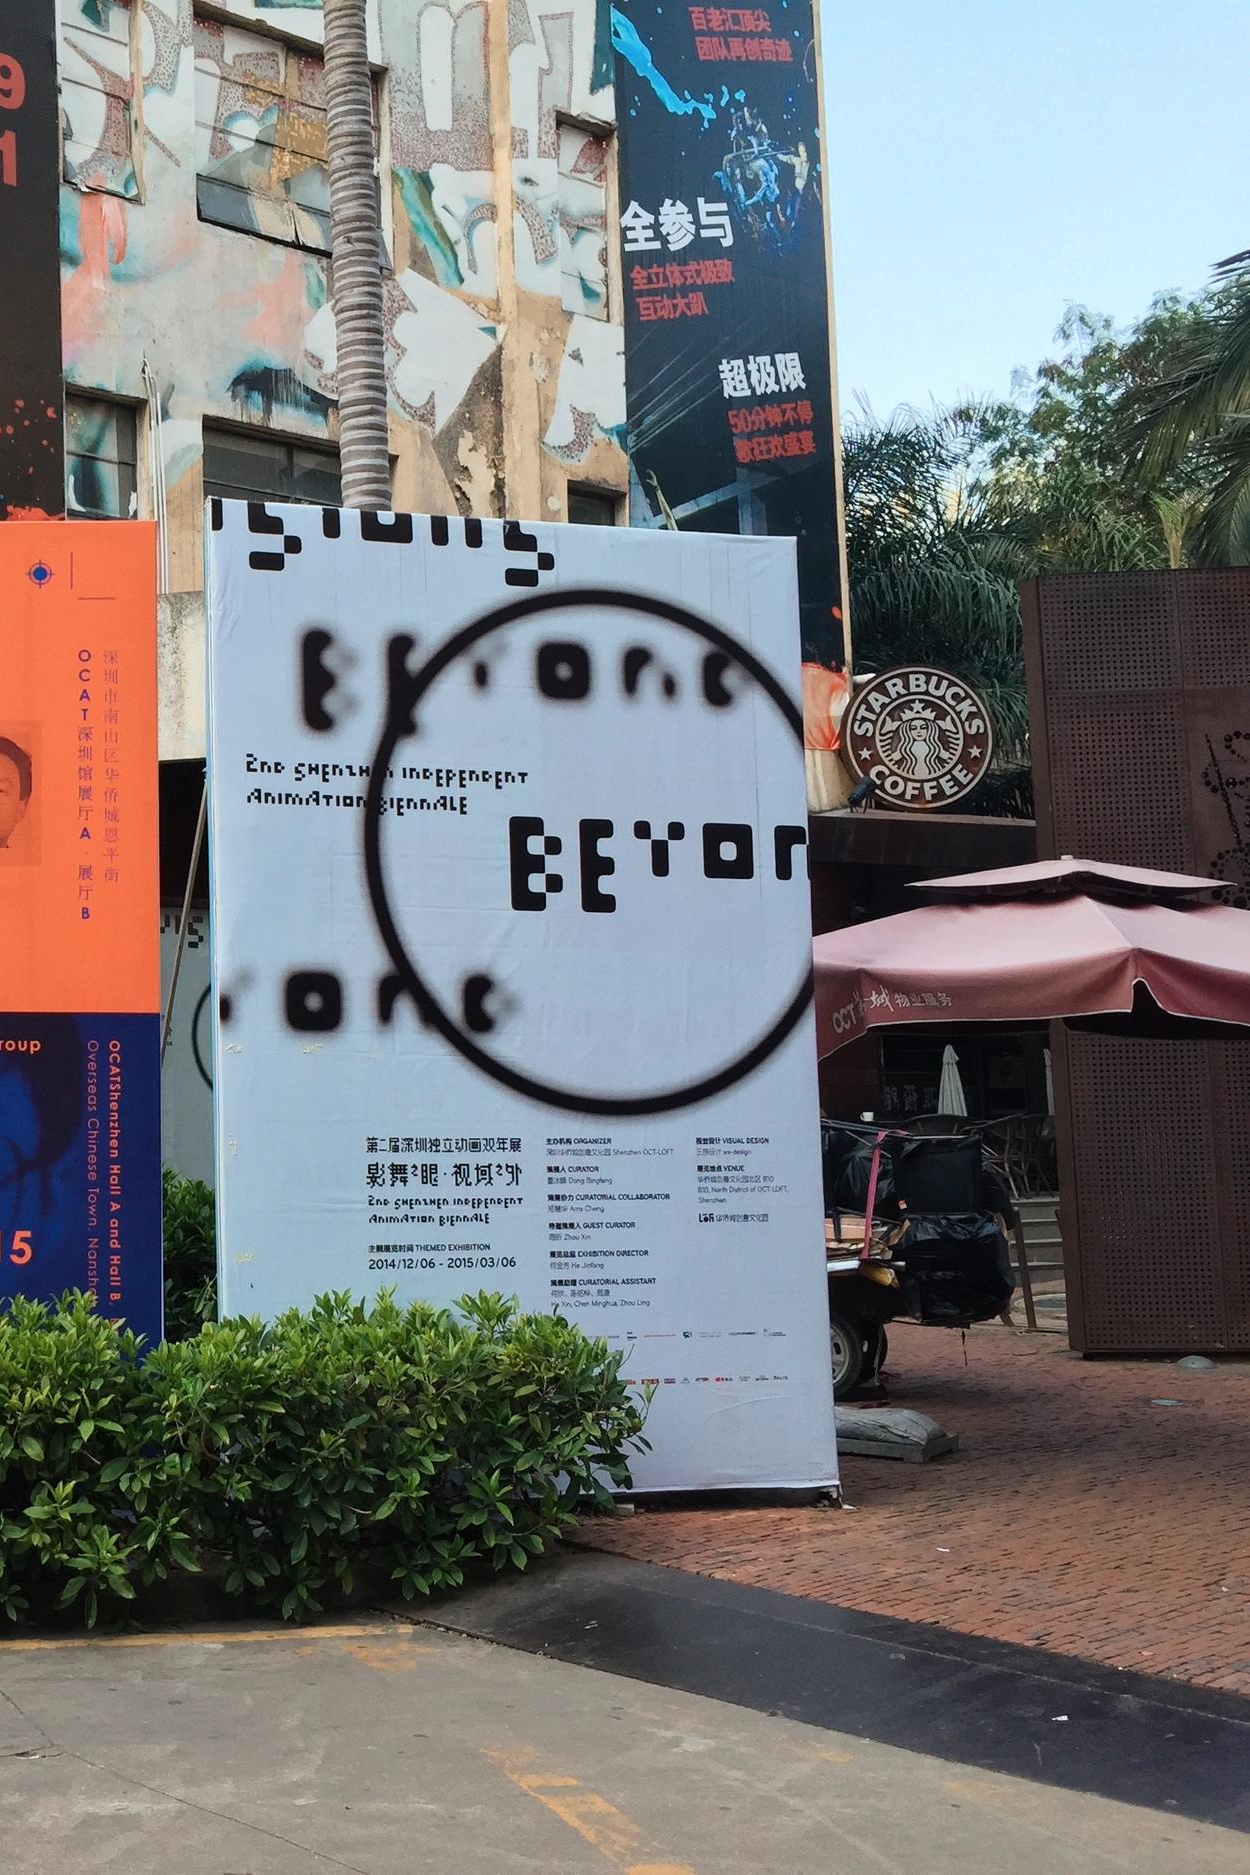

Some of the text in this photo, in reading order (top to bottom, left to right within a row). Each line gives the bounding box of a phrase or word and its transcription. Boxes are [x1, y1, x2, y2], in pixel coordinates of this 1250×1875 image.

[620, 197, 734, 252] 全参与
[718, 352, 806, 399] 超极限
[853, 673, 985, 738] STARBUCKS
[868, 763, 973, 801] COFFEE
[832, 1003, 857, 1034] OCT
[87, 1040, 100, 1113] Overseas
[87, 1118, 100, 1182] Chinese
[573, 1137, 612, 1145] ORGANIZER
[109, 1164, 121, 1196] Hall
[109, 1202, 121, 1213] A
[109, 1218, 121, 1249] and
[415, 1243, 491, 1252] THEMED EXHIBITION
[368, 1256, 517, 1270] 2014/12/06 2015/03/06
[616, 1249, 649, 1257] DIRECTOR
[109, 1255, 121, 1287] Hall
